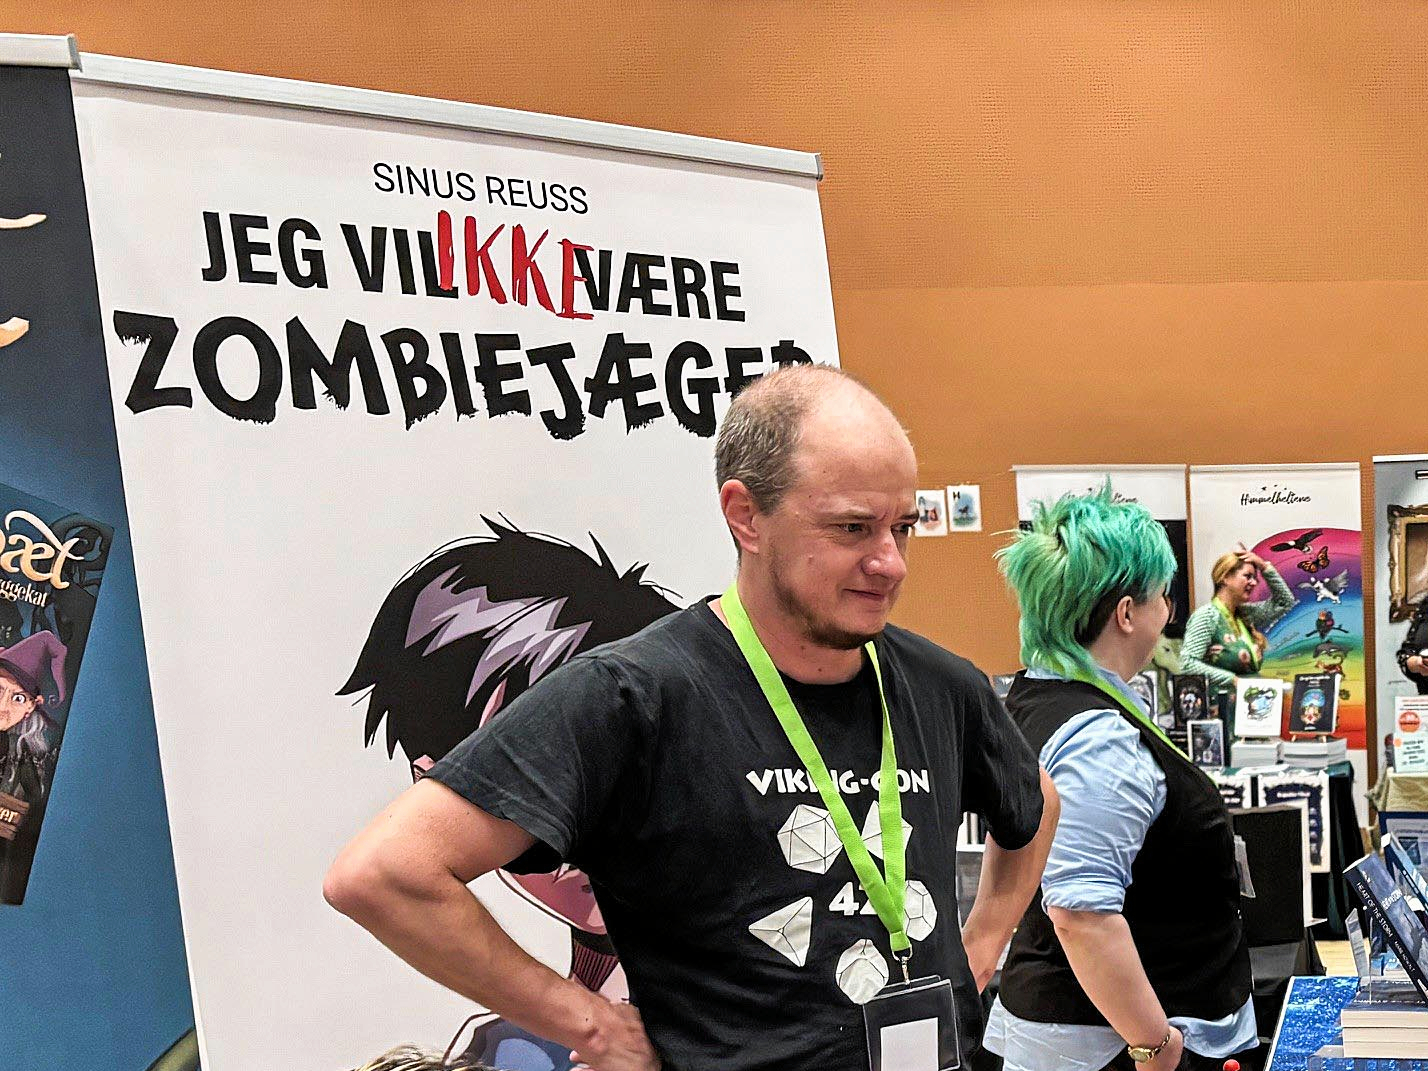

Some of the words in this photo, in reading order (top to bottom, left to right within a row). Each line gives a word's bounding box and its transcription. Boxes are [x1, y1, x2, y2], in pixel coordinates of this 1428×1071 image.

[373, 162, 476, 201] SINUS
[486, 177, 589, 215] REUSS
[201, 211, 328, 290] JEG
[340, 223, 459, 300] VIL
[436, 210, 595, 321] IKKE
[578, 247, 746, 324] VÆRE
[112, 309, 816, 442] ZOMBIEJÆGE
